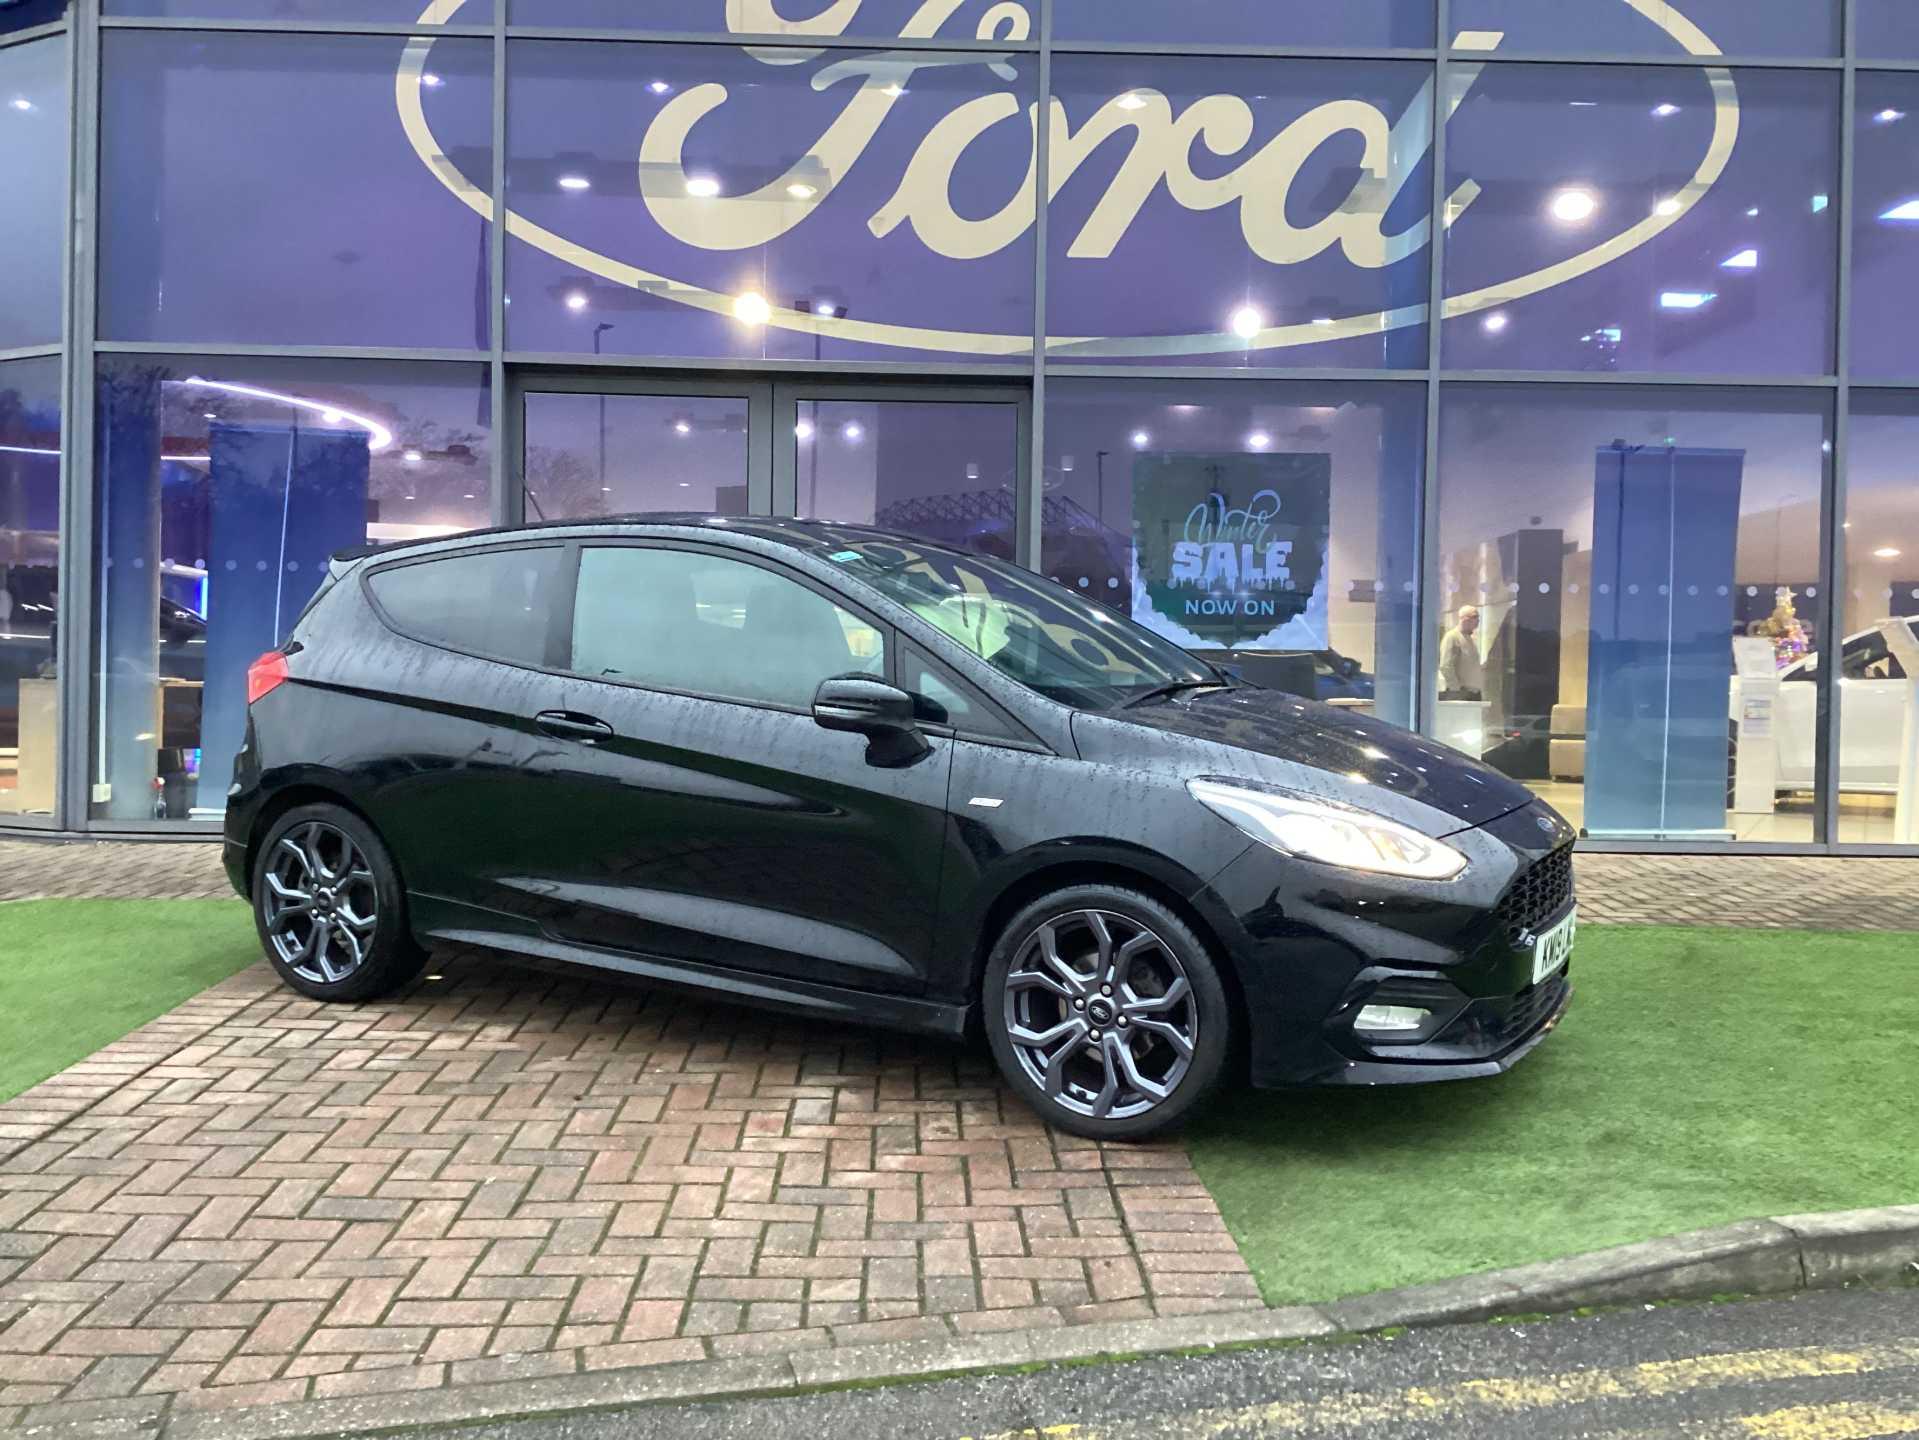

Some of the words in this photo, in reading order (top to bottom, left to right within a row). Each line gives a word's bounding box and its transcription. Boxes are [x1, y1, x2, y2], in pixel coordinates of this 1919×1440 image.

[638, 0, 1504, 268] Ford
[1171, 541, 1293, 591] SALE
[1185, 599, 1236, 615] NOW
[1243, 599, 1275, 615] ON
